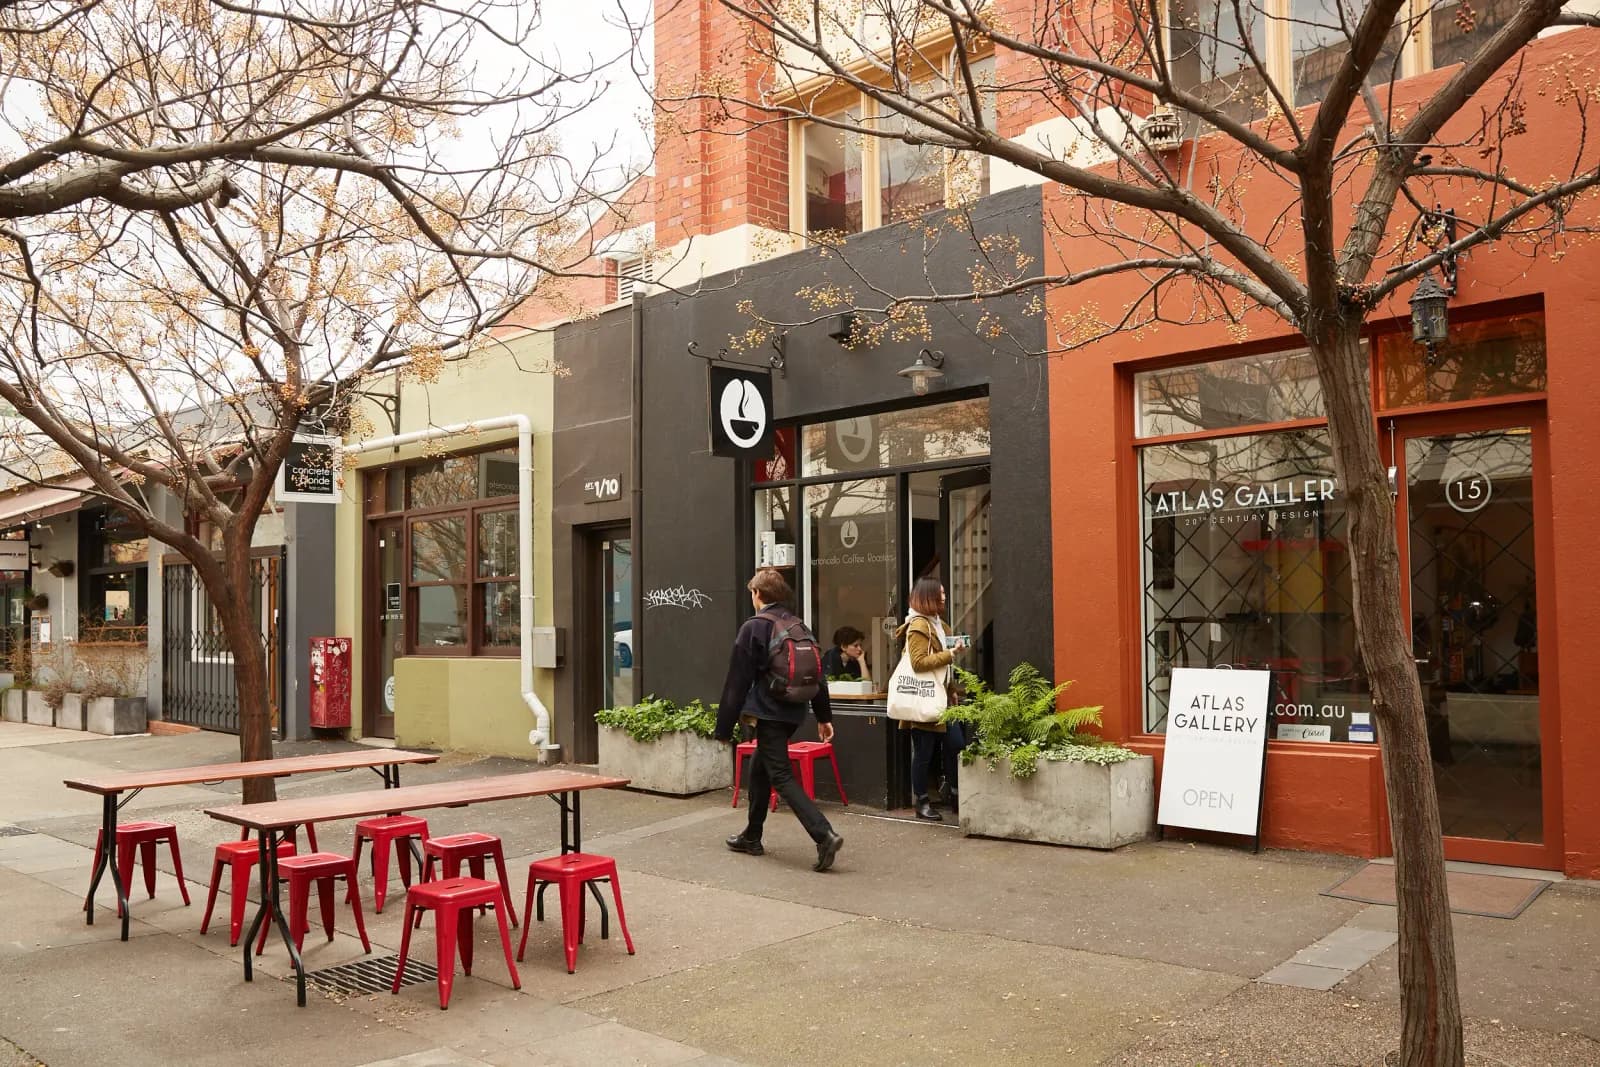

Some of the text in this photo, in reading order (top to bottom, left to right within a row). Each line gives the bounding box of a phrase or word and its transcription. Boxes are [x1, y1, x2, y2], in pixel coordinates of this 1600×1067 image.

[292, 466, 330, 476] concrete
[594, 478, 619, 498] 1/10
[1155, 479, 1338, 513] ATLAS GALLER
[1456, 480, 1481, 500] 15
[1212, 513, 1265, 524] CENTURY
[1273, 510, 1319, 520] DESIGN
[842, 554, 865, 565] Coffee
[1190, 694, 1245, 712] ATLAS
[1174, 713, 1258, 733] GALLERY
[1182, 788, 1234, 810] OPEN
